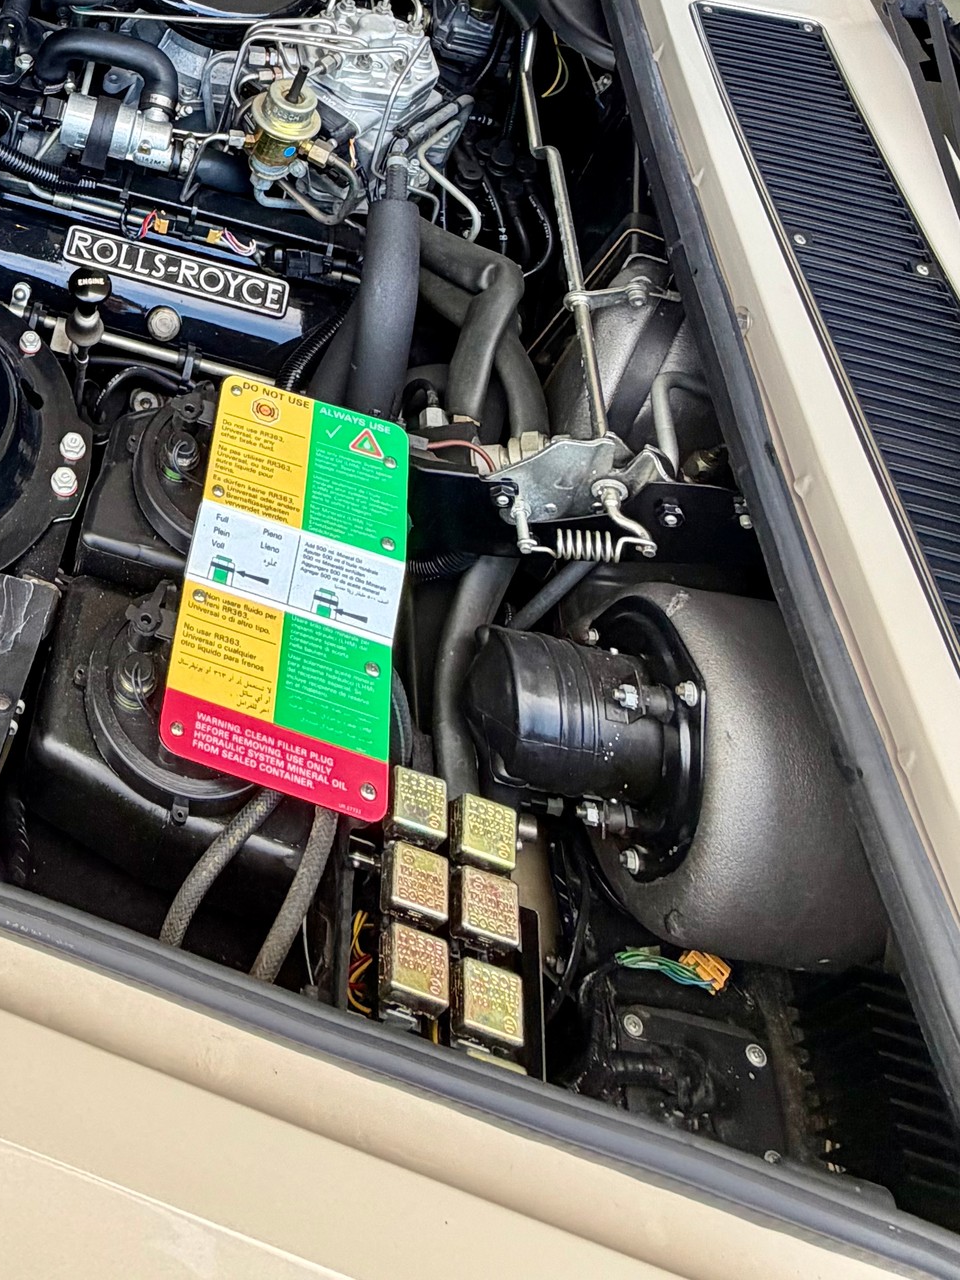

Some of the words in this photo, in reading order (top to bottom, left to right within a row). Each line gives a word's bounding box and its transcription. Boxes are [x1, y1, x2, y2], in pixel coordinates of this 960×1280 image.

[70, 231, 283, 310] ROLLS-ROYCE
[77, 278, 104, 286] ENGINE
[242, 381, 258, 393] DO
[262, 388, 284, 401] NOT
[288, 396, 310, 409] USE
[319, 406, 366, 427] ALWAYS
[369, 421, 391, 434] USE
[213, 525, 230, 537] Plein
[215, 512, 229, 523] Full
[210, 538, 225, 549] Voll
[262, 527, 282, 540] Pieno
[187, 601, 219, 617] Universal
[228, 615, 235, 623] di
[236, 618, 253, 629] altro
[203, 599, 219, 610] freni
[205, 591, 220, 602] Non
[222, 598, 241, 609] usare
[243, 604, 263, 616] fluido
[264, 612, 276, 621] per
[183, 621, 194, 631] No
[196, 627, 211, 637] usar
[180, 639, 195, 649] otro
[223, 653, 239, 664] para
[241, 658, 264, 672] frenos
[182, 630, 215, 647] Universal
[223, 644, 256, 661] cualquier
[194, 721, 230, 739] BEFORE
[231, 734, 283, 758] REMOVING.
[285, 753, 304, 765] USE
[306, 760, 331, 775] ONLY
[196, 711, 242, 733] WARNING.
[244, 728, 274, 745] CLEAN
[277, 739, 307, 756] FILLER
[309, 751, 334, 766] PLUG
[191, 739, 219, 755] FROM
[221, 749, 257, 768] SEALED
[259, 762, 315, 788] CONTAINER.
[193, 730, 245, 754] HYDRAULIC
[247, 749, 284, 768] SYSTEM
[287, 763, 330, 784] MINERAL
[331, 778, 347, 790] OIL
